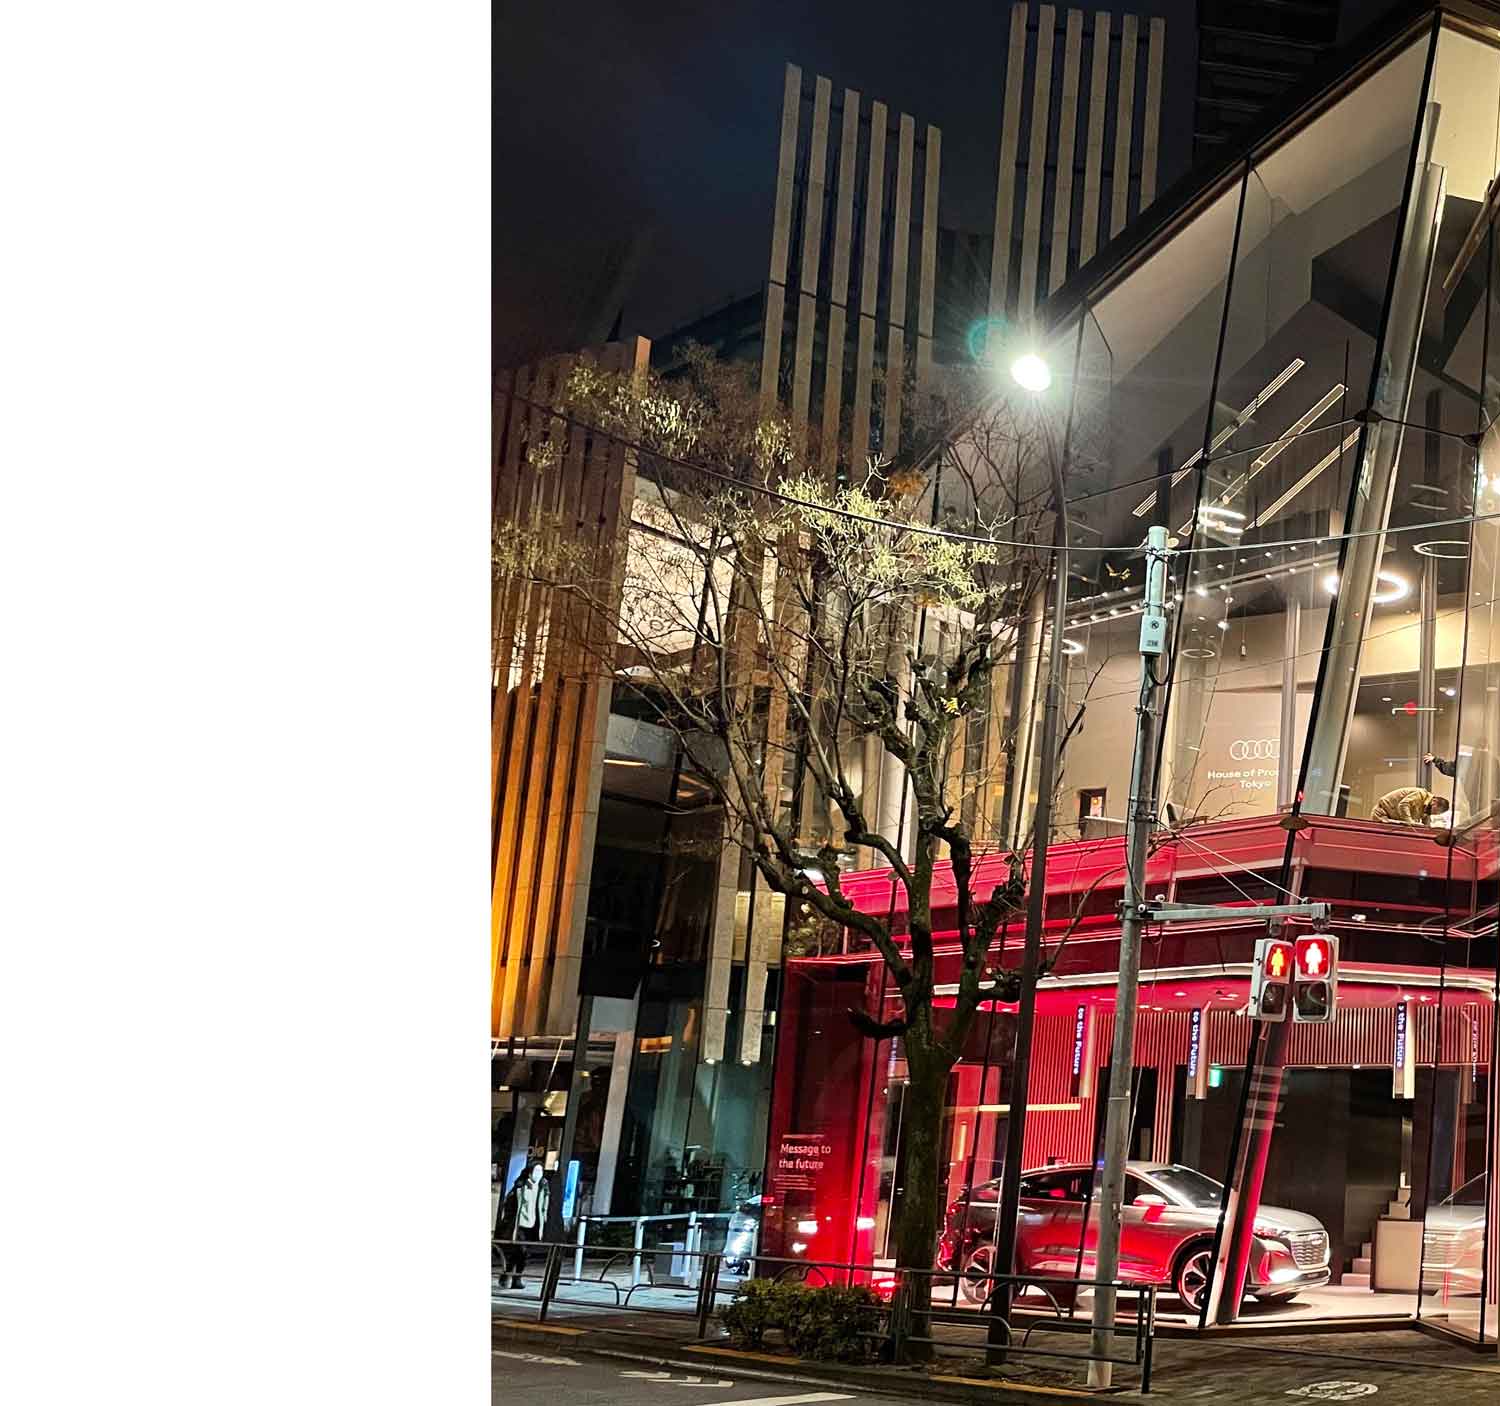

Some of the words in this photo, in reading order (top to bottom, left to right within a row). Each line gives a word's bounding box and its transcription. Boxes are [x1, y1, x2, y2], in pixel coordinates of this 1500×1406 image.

[1207, 770, 1241, 779] House
[1243, 769, 1256, 777] of
[1076, 1021, 1084, 1039] the
[1191, 1024, 1199, 1041] the
[1073, 1041, 1083, 1075] Future
[1189, 1043, 1198, 1077] Future
[781, 1144, 819, 1156] Message
[821, 1145, 832, 1154] to
[779, 1158, 794, 1168] the
[795, 1159, 824, 1168] future
